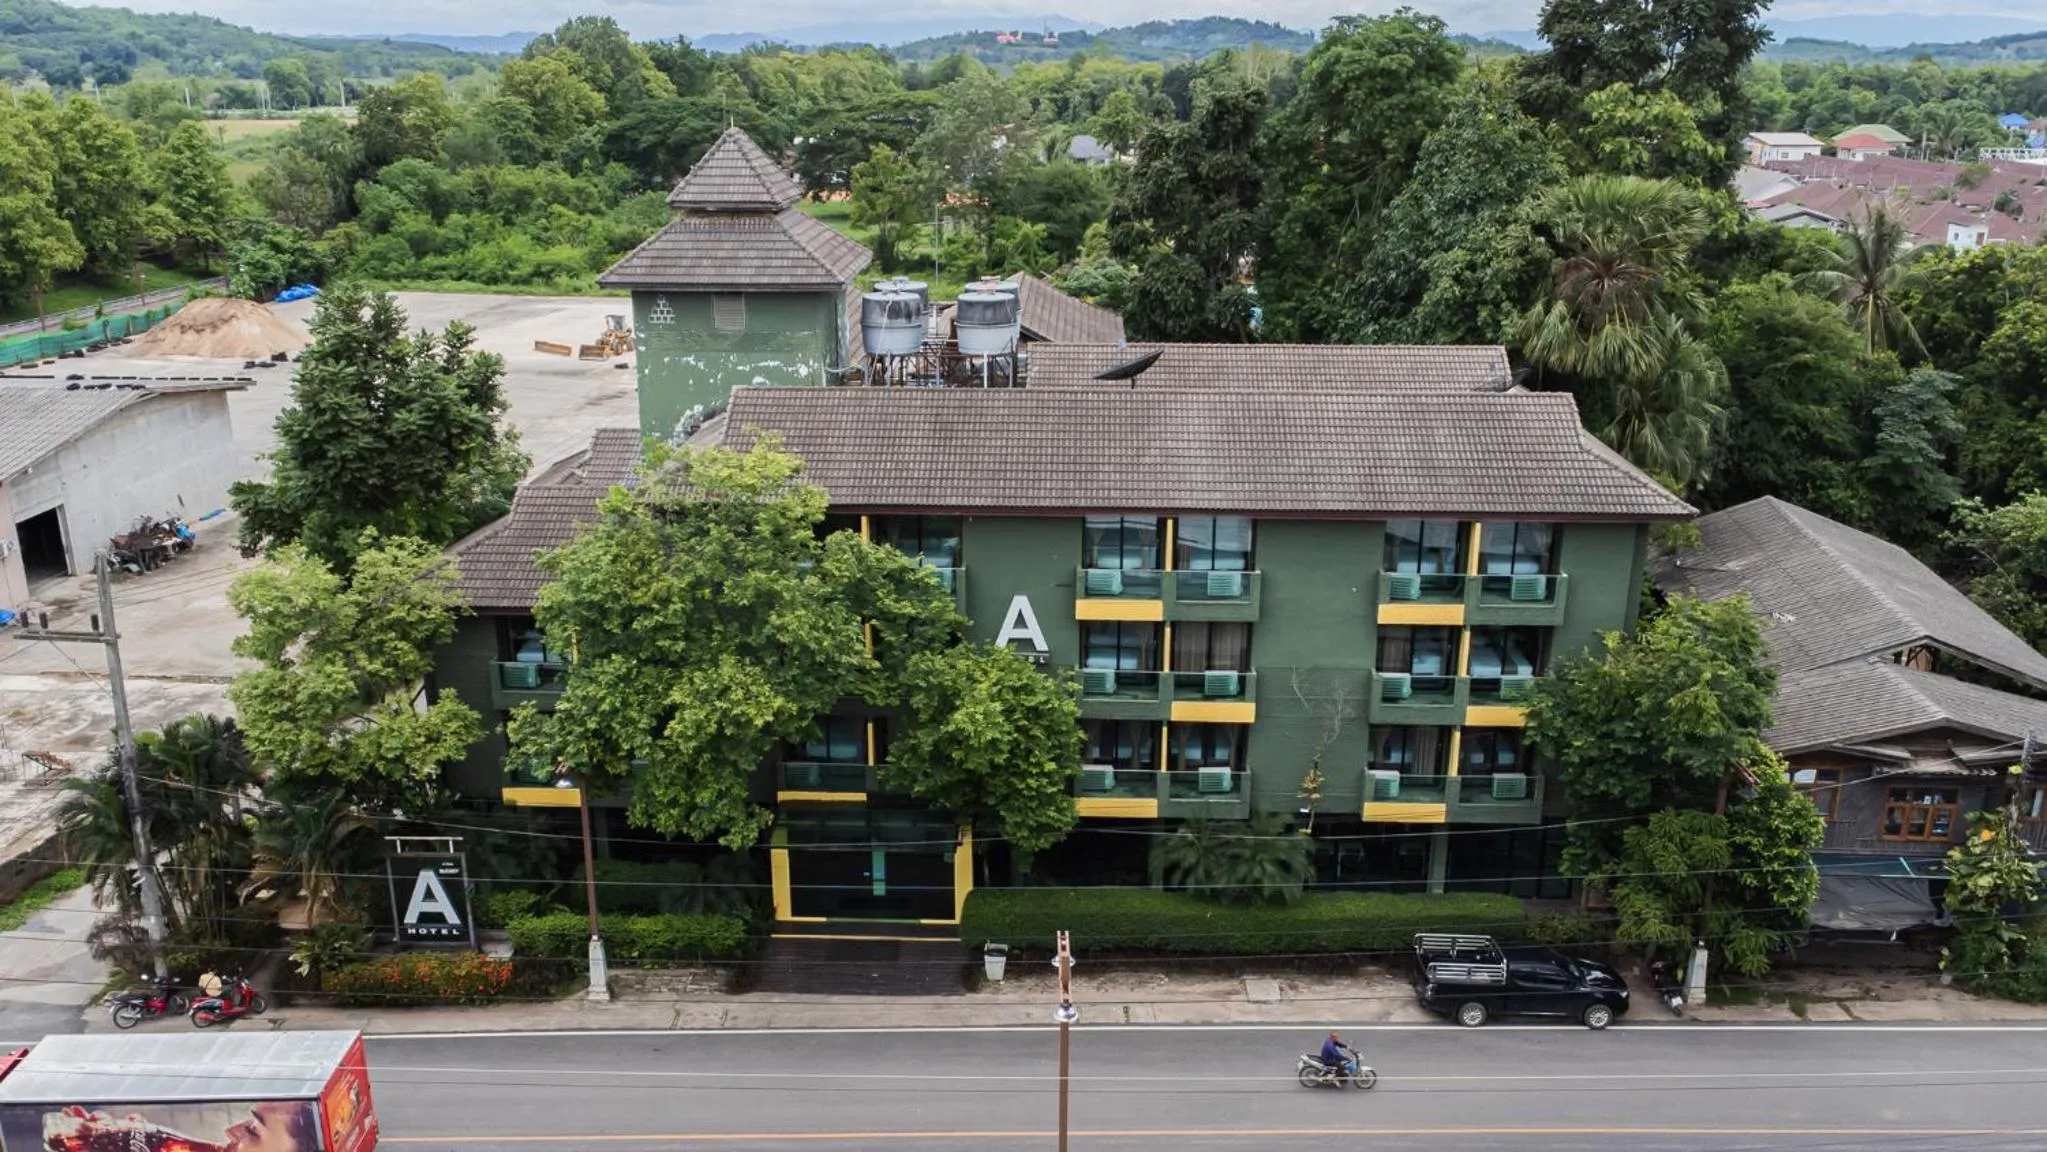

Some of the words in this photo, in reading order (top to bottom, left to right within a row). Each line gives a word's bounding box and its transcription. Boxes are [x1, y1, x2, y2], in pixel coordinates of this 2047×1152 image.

[994, 595, 1049, 651] A
[403, 869, 461, 925] A
[407, 927, 460, 935] HOTEL
